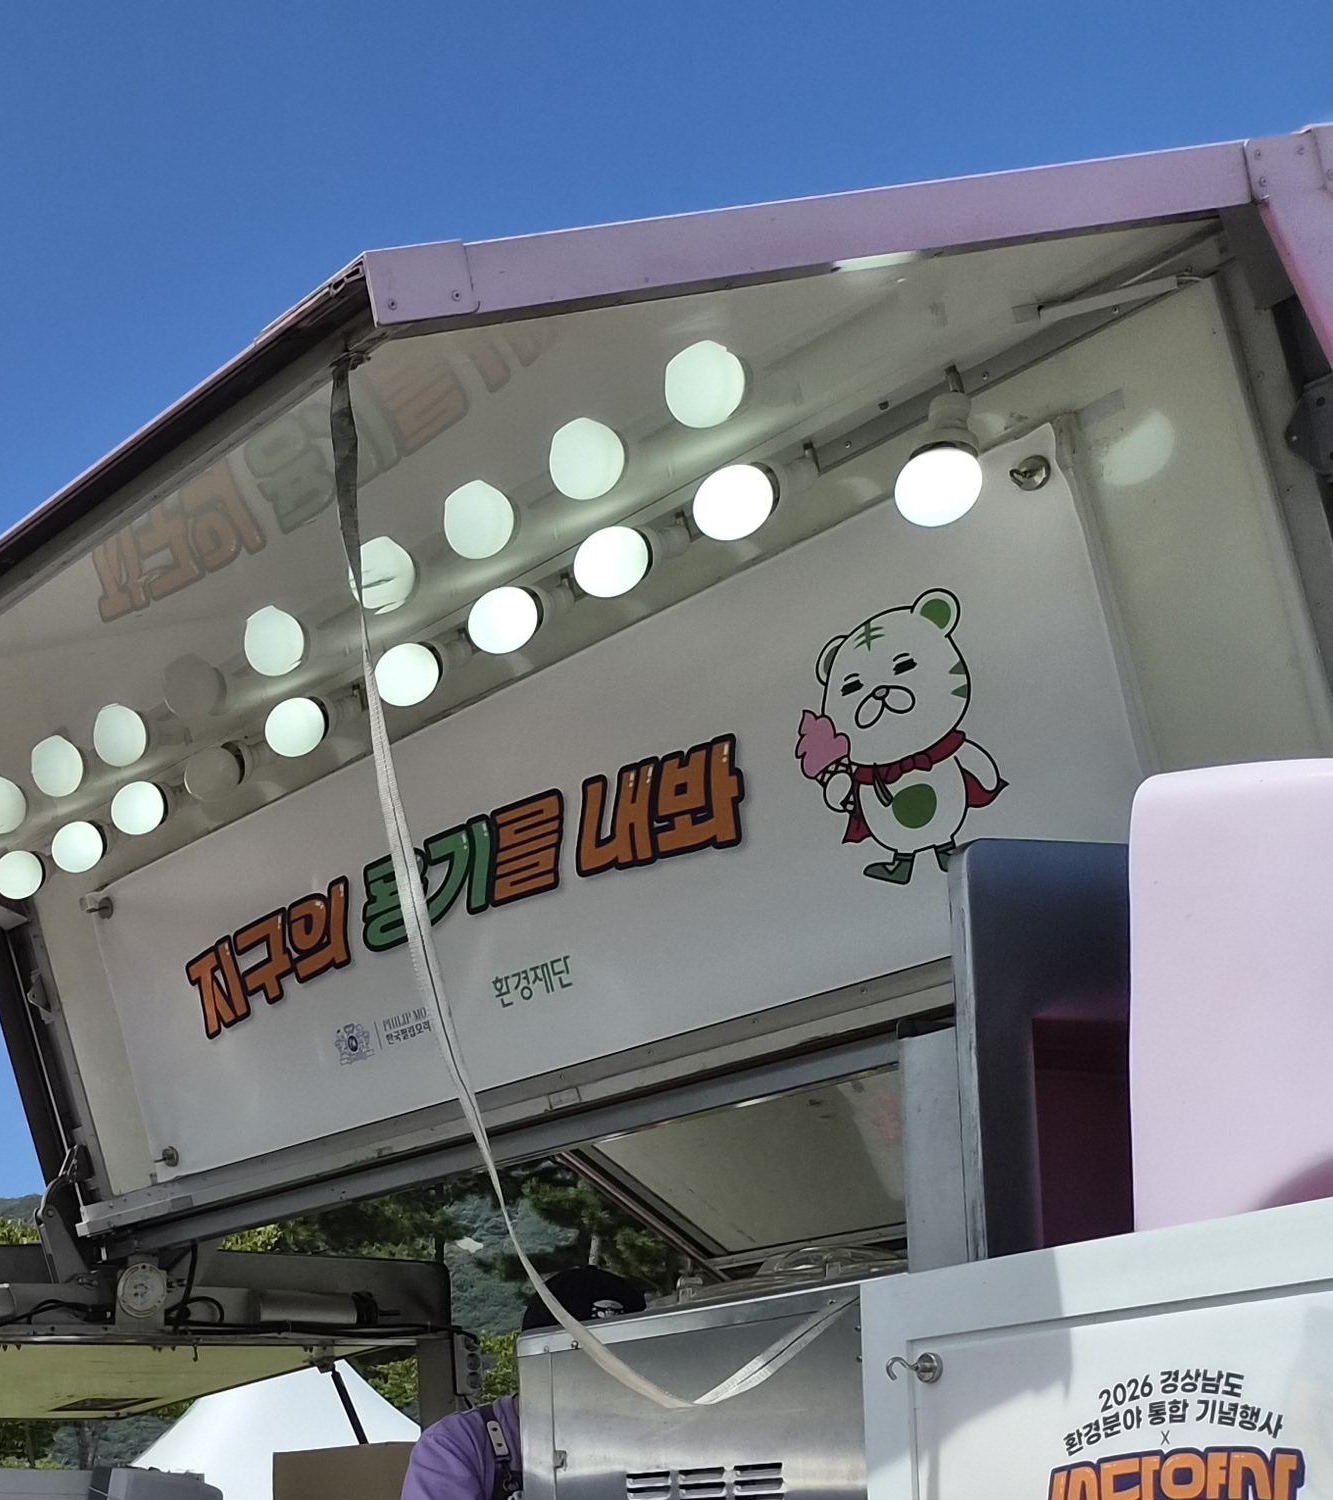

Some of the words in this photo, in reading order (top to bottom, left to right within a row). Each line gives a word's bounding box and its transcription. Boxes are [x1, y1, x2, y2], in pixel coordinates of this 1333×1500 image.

[186, 875, 351, 1039] 지구의
[362, 788, 564, 952] 용기를
[575, 733, 745, 877] 내봐
[492, 955, 573, 1008] 환경재단
[386, 1020, 432, 1045] 한국필립모리
[1098, 1374, 1153, 1412] 2026
[1160, 1368, 1245, 1398] 경상남도
[1063, 1405, 1142, 1456] 환경분야
[1148, 1399, 1189, 1426] 통합
[1195, 1399, 1284, 1439] 기념행사
